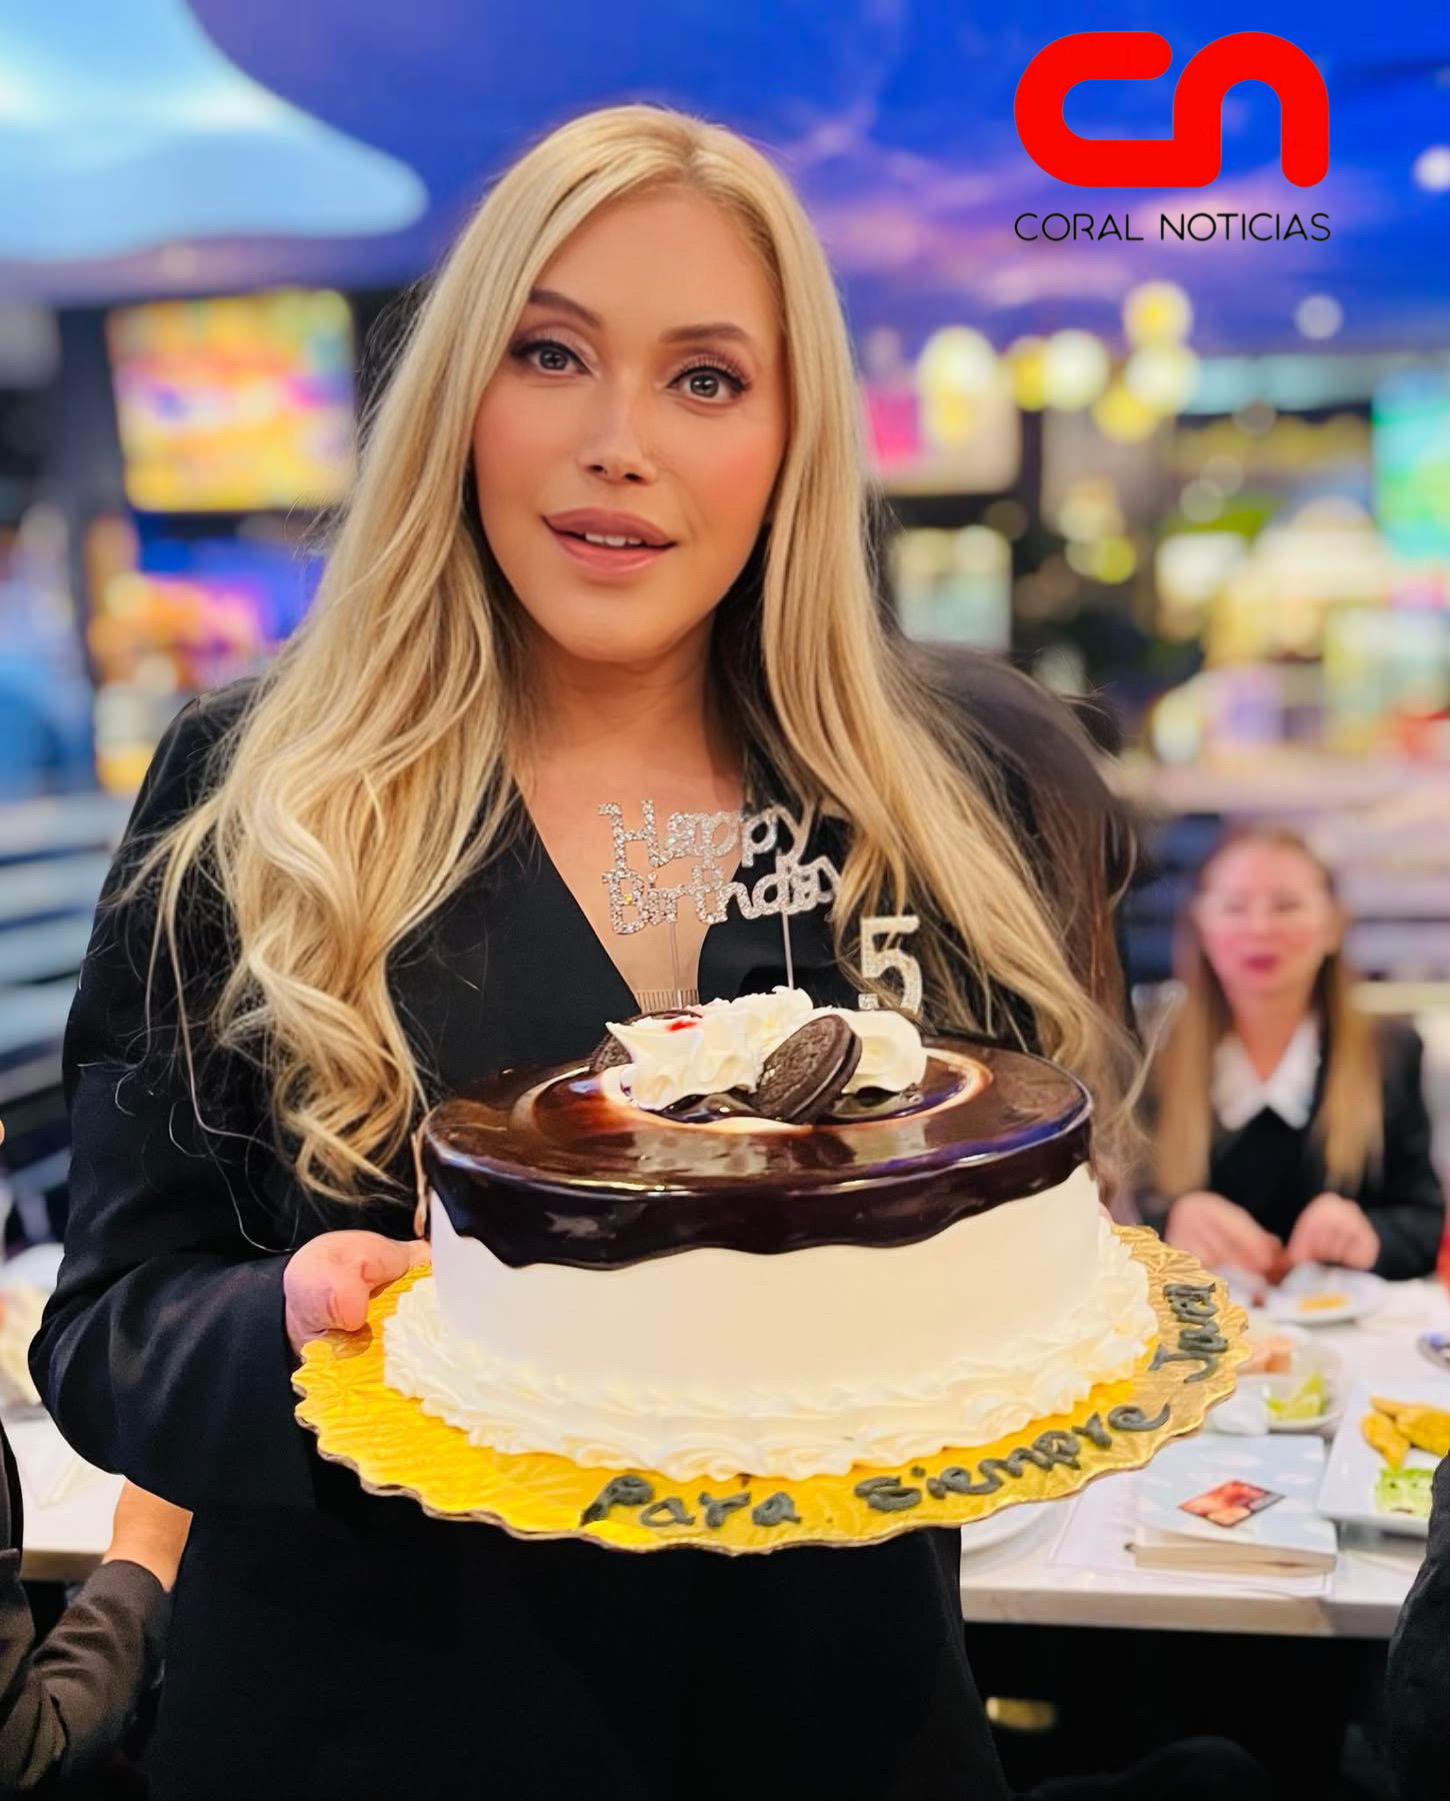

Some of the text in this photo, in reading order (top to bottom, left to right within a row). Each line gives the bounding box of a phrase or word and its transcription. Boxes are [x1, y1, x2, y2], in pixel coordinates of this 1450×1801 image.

[598, 799, 817, 868] Happy
[602, 852, 843, 935] Birthday
[858, 915, 923, 1015] 5
[579, 1474, 802, 1528] Para
[854, 1403, 1171, 1512] Siempre
